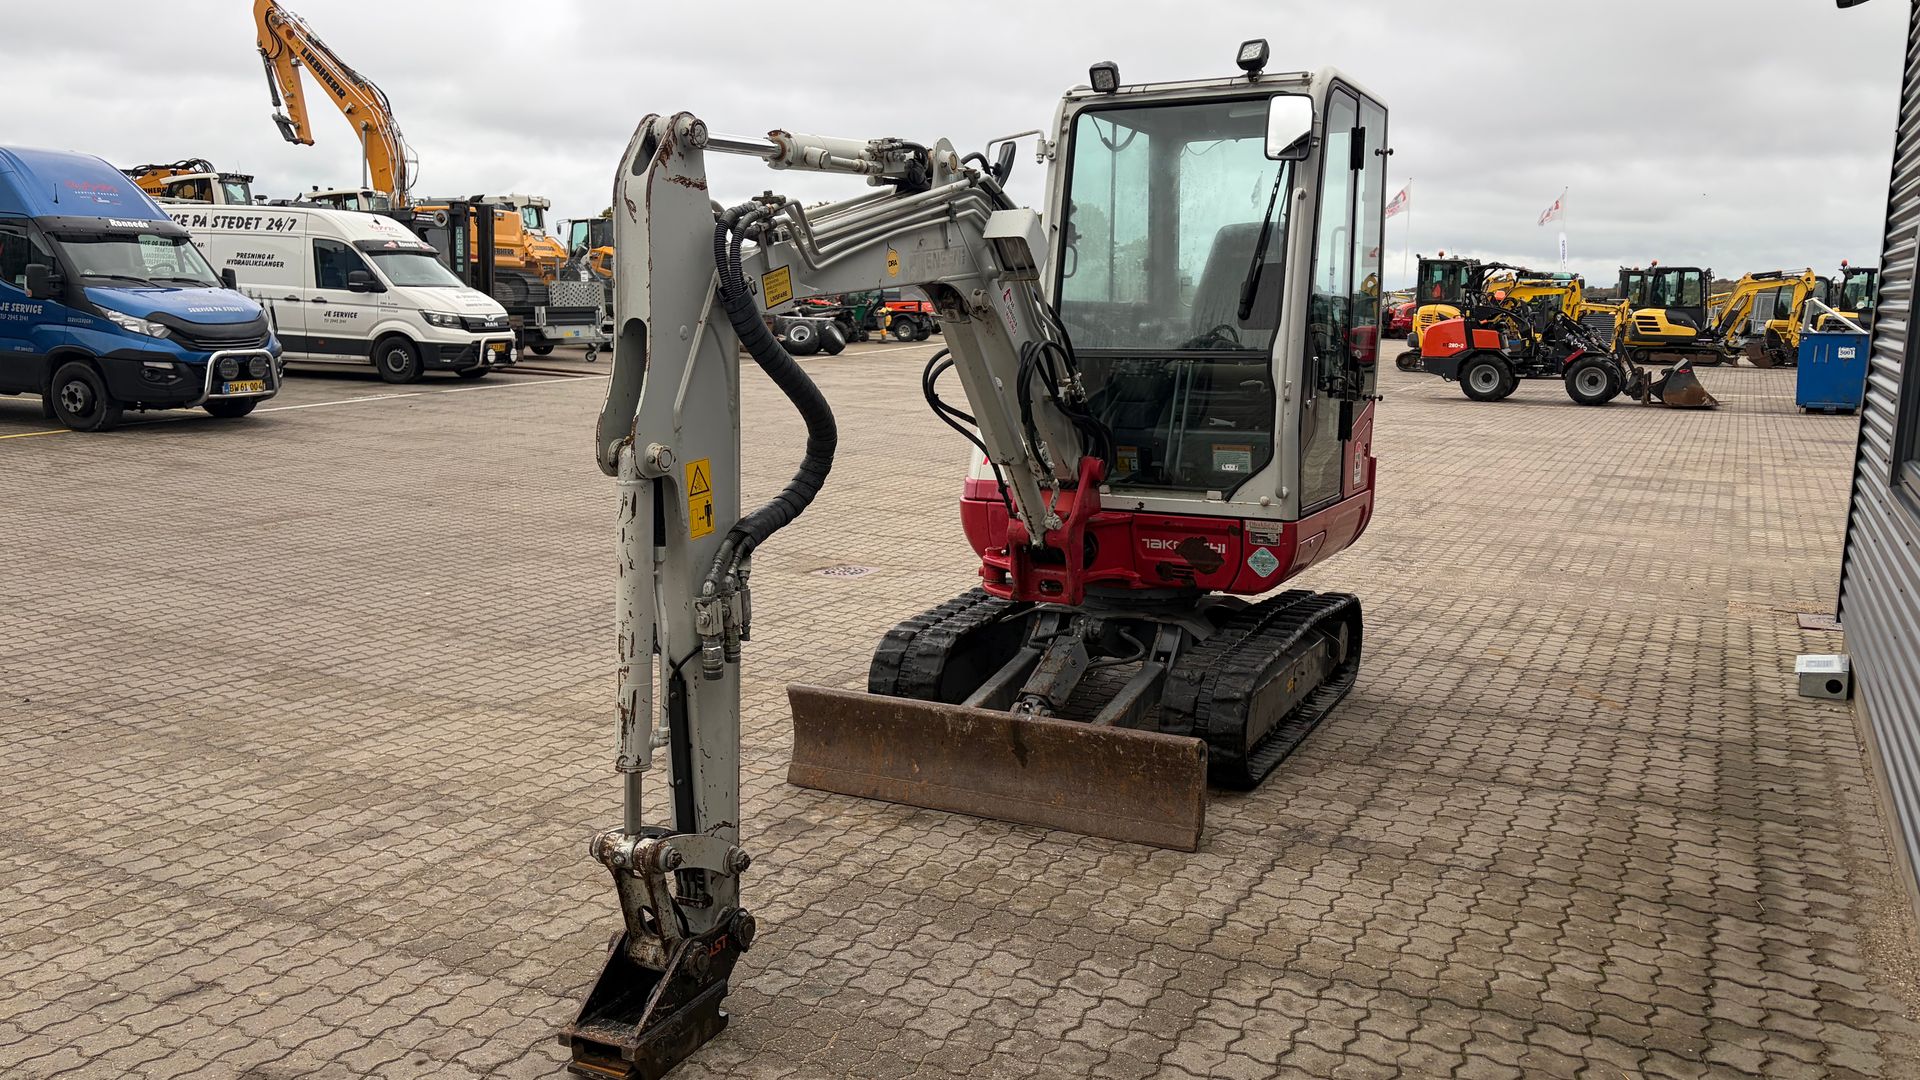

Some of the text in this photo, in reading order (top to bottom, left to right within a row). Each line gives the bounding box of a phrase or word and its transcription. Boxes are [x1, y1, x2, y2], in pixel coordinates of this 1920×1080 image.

[301, 47, 346, 100] LIEBHERR
[211, 215, 262, 230] STEDET
[265, 216, 297, 232] 24/7
[236, 252, 266, 260] PRESNING
[226, 260, 284, 268] HYDRAULIKSLANGER
[0, 302, 43, 314] JE SERVICE
